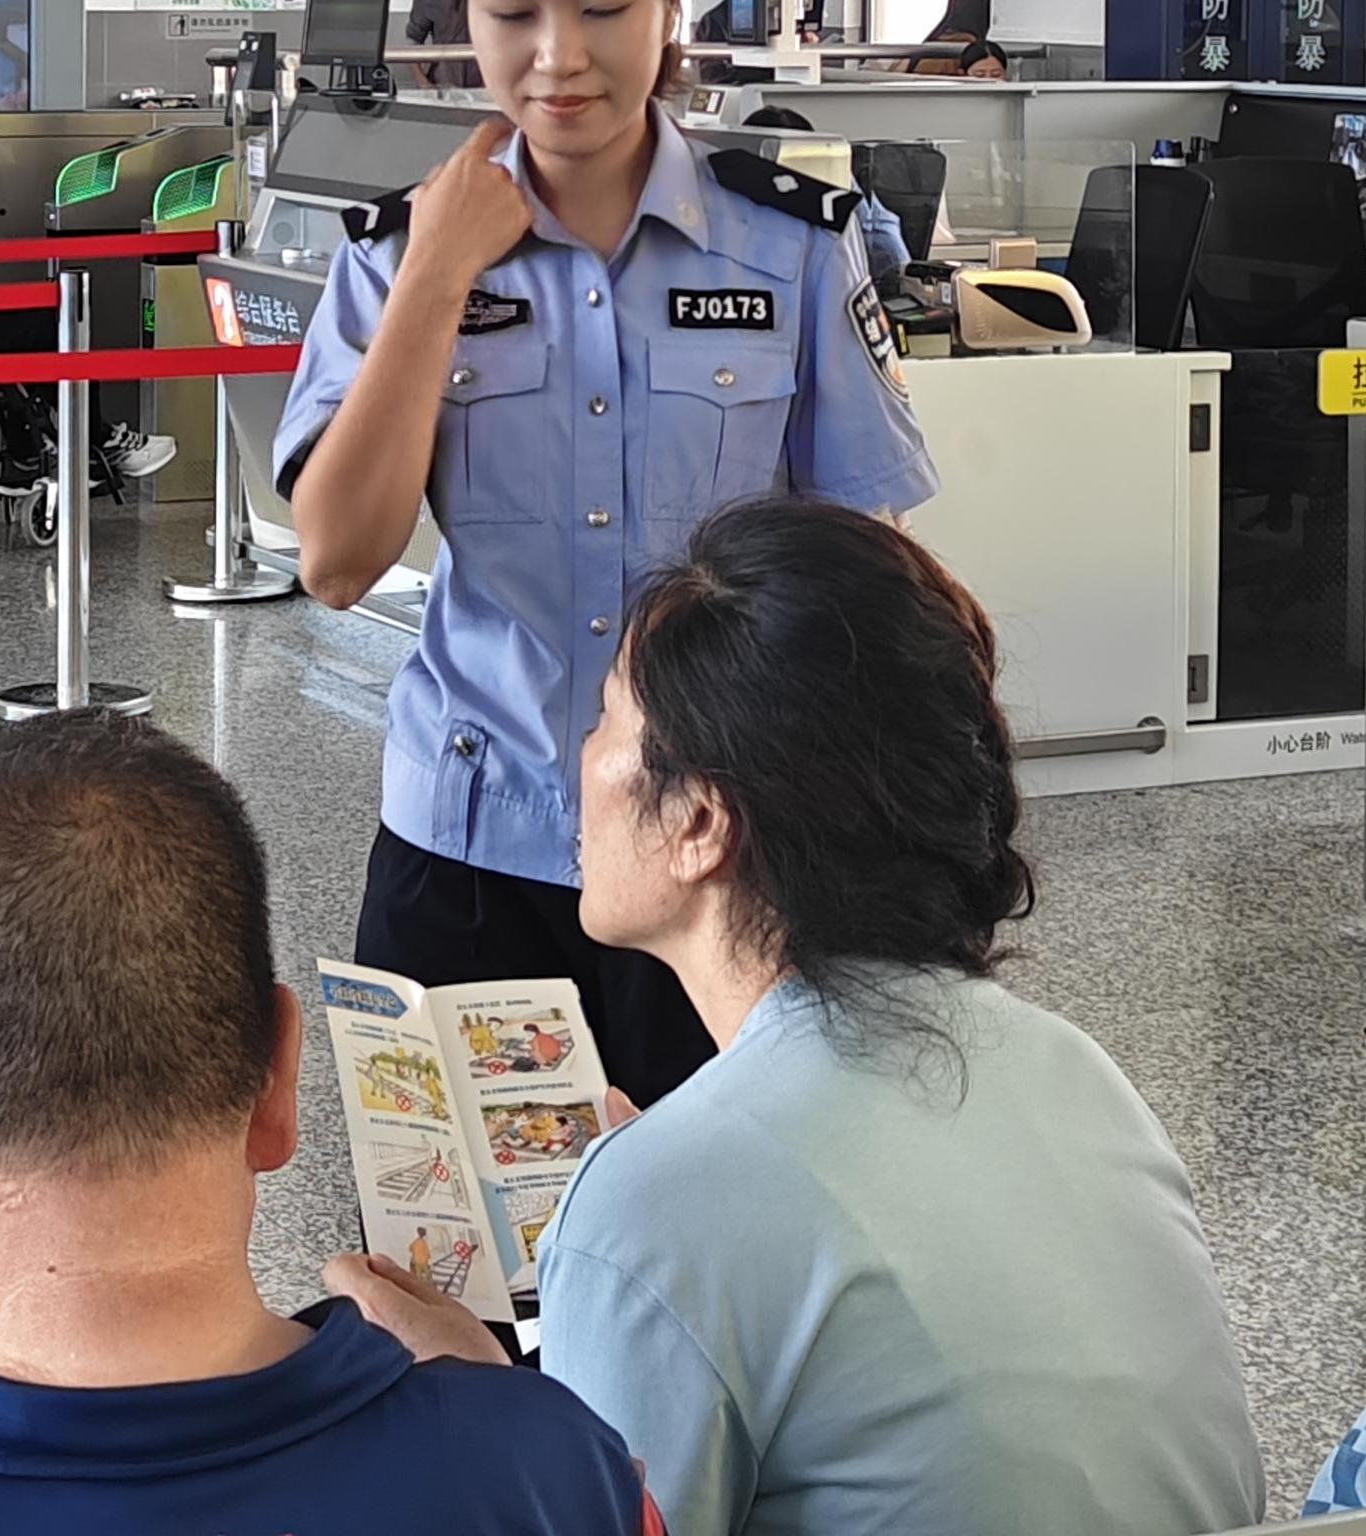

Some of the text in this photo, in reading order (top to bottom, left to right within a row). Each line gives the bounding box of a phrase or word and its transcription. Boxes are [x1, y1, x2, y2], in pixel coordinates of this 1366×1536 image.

[676, 295, 767, 322] FJ0173
[1267, 731, 1331, 755] 小心台阶
